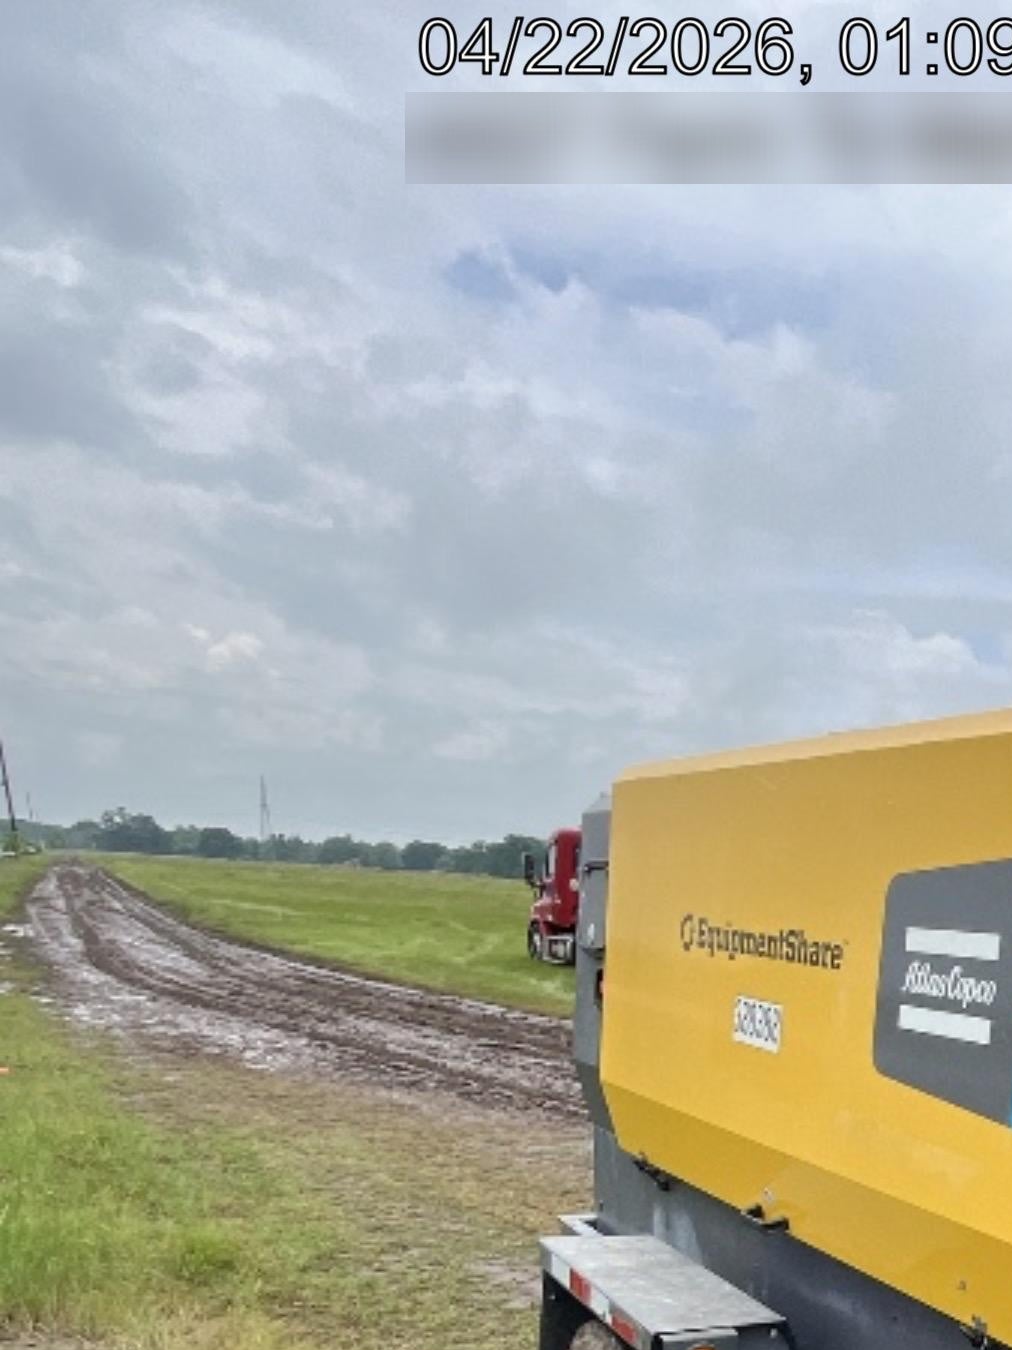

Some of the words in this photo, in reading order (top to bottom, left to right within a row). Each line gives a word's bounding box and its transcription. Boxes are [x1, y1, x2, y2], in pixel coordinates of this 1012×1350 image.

[696, 917, 844, 970] EquipmentShare
[901, 959, 947, 999] Atlas
[947, 964, 996, 1009] Copco
